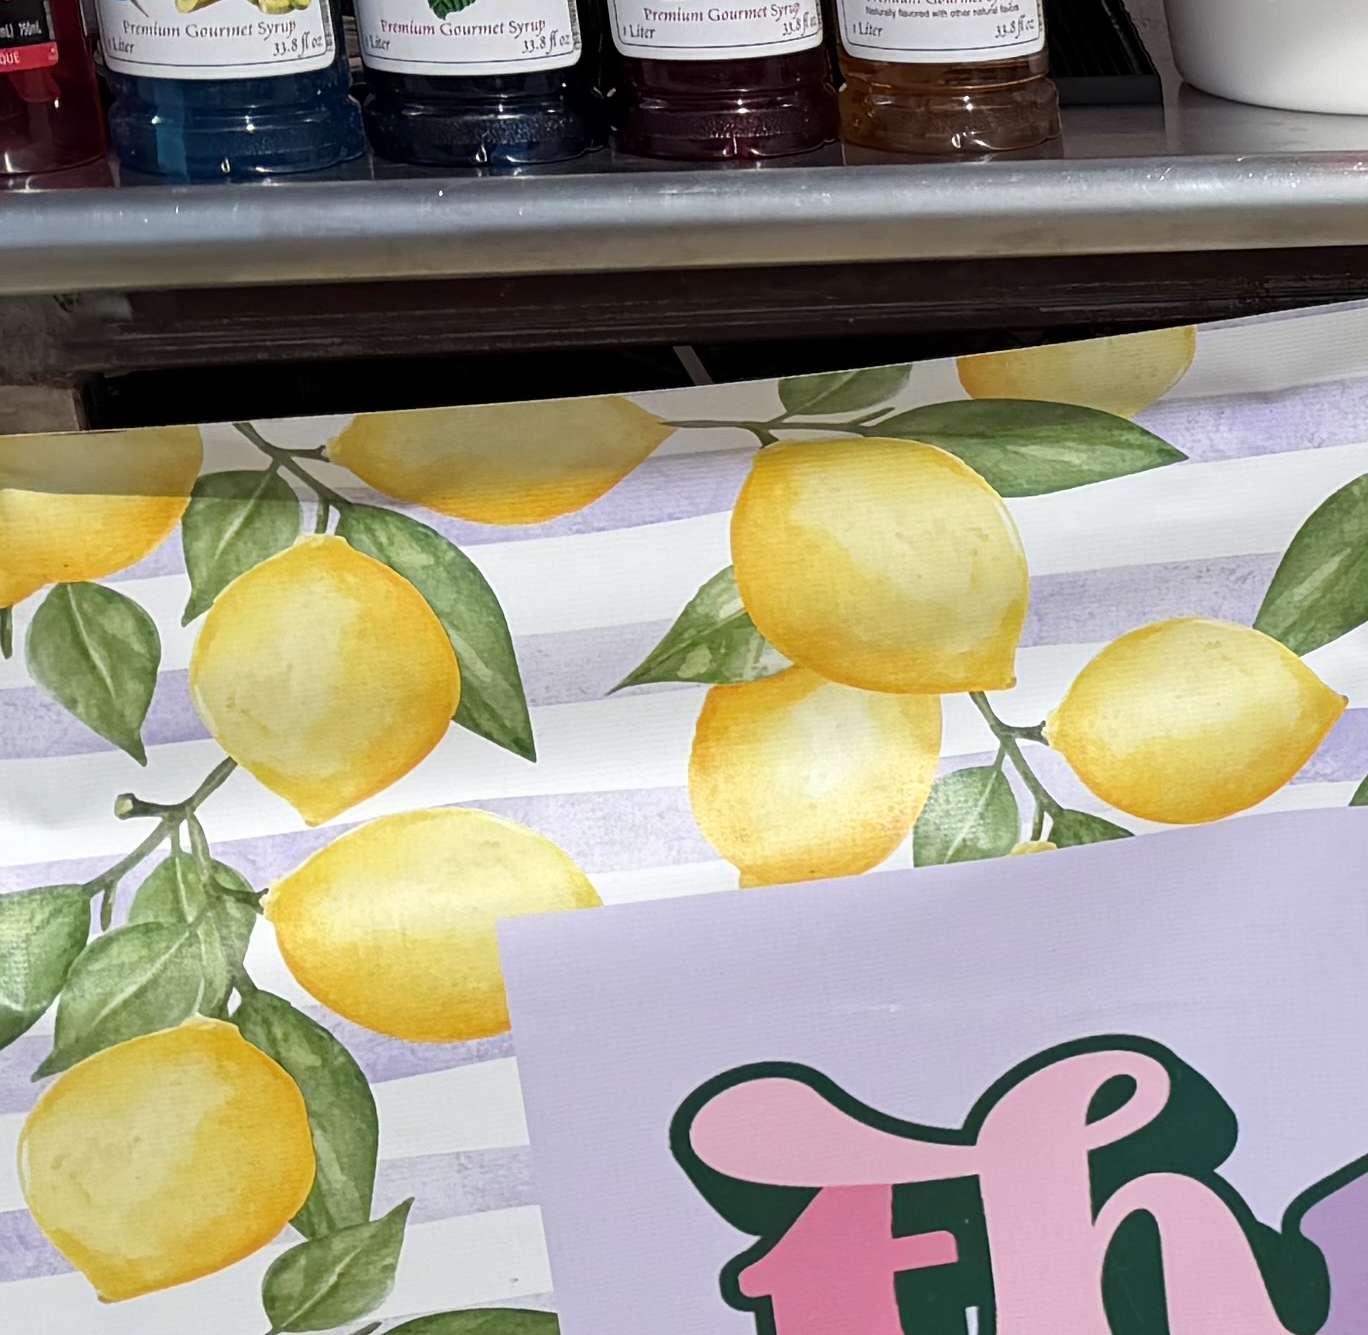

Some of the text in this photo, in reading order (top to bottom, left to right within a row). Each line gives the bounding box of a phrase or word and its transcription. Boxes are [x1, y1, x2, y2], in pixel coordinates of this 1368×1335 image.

[643, 2, 800, 22] Premium Gourmet Syrup
[123, 19, 297, 41] Premium Gourmet Syrup
[381, 19, 546, 39] Premium Gourmet Syrup
[629, 24, 655, 39] Liter
[859, 21, 883, 37] Liter
[272, 37, 299, 57] 33.8
